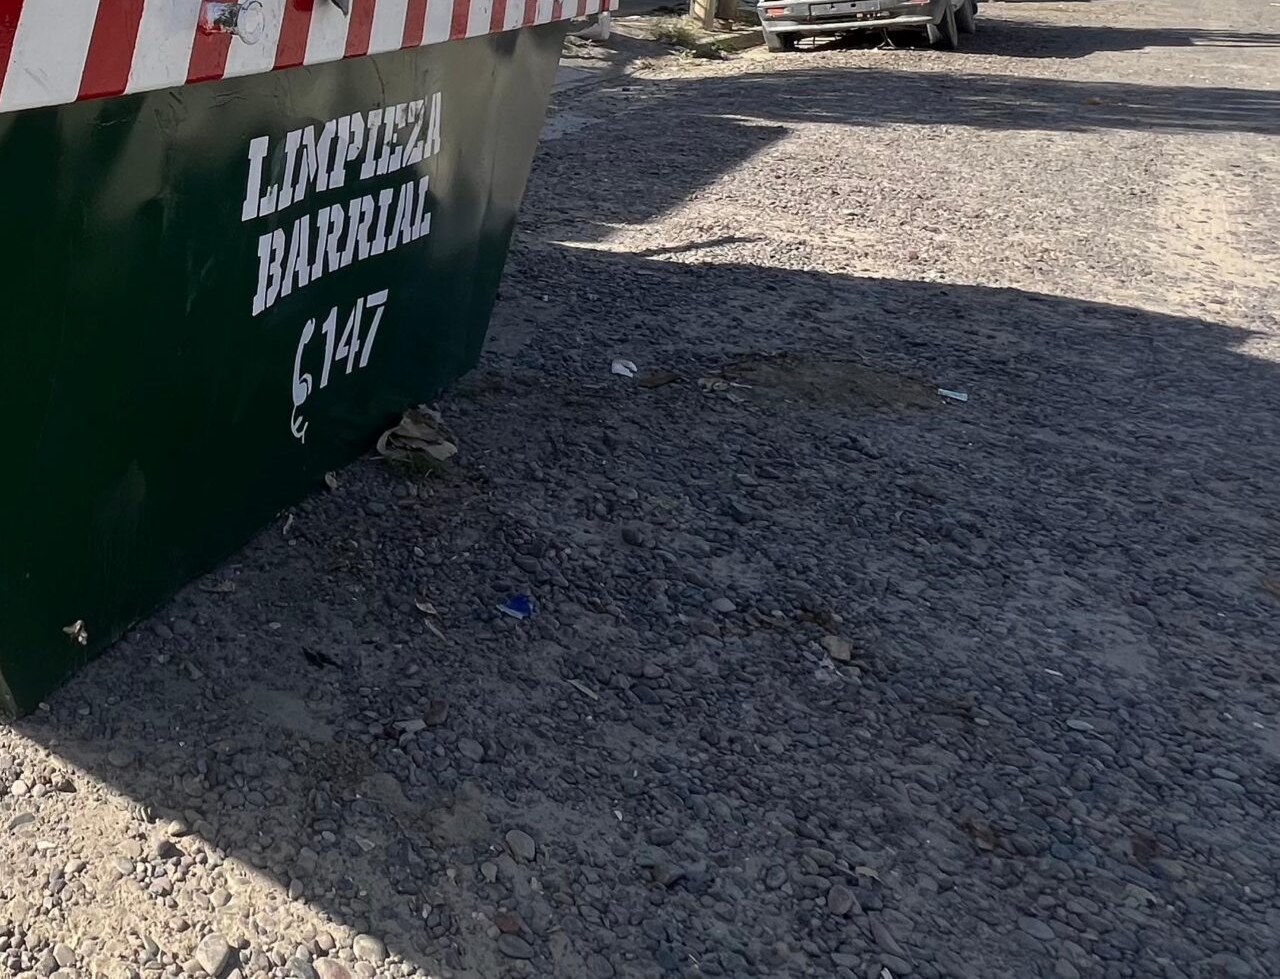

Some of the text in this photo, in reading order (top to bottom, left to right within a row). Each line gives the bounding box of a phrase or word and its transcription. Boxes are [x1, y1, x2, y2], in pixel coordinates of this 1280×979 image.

[241, 91, 442, 222] LIMPIEZA
[252, 175, 432, 317] BARRIAL
[319, 288, 389, 390] 147
